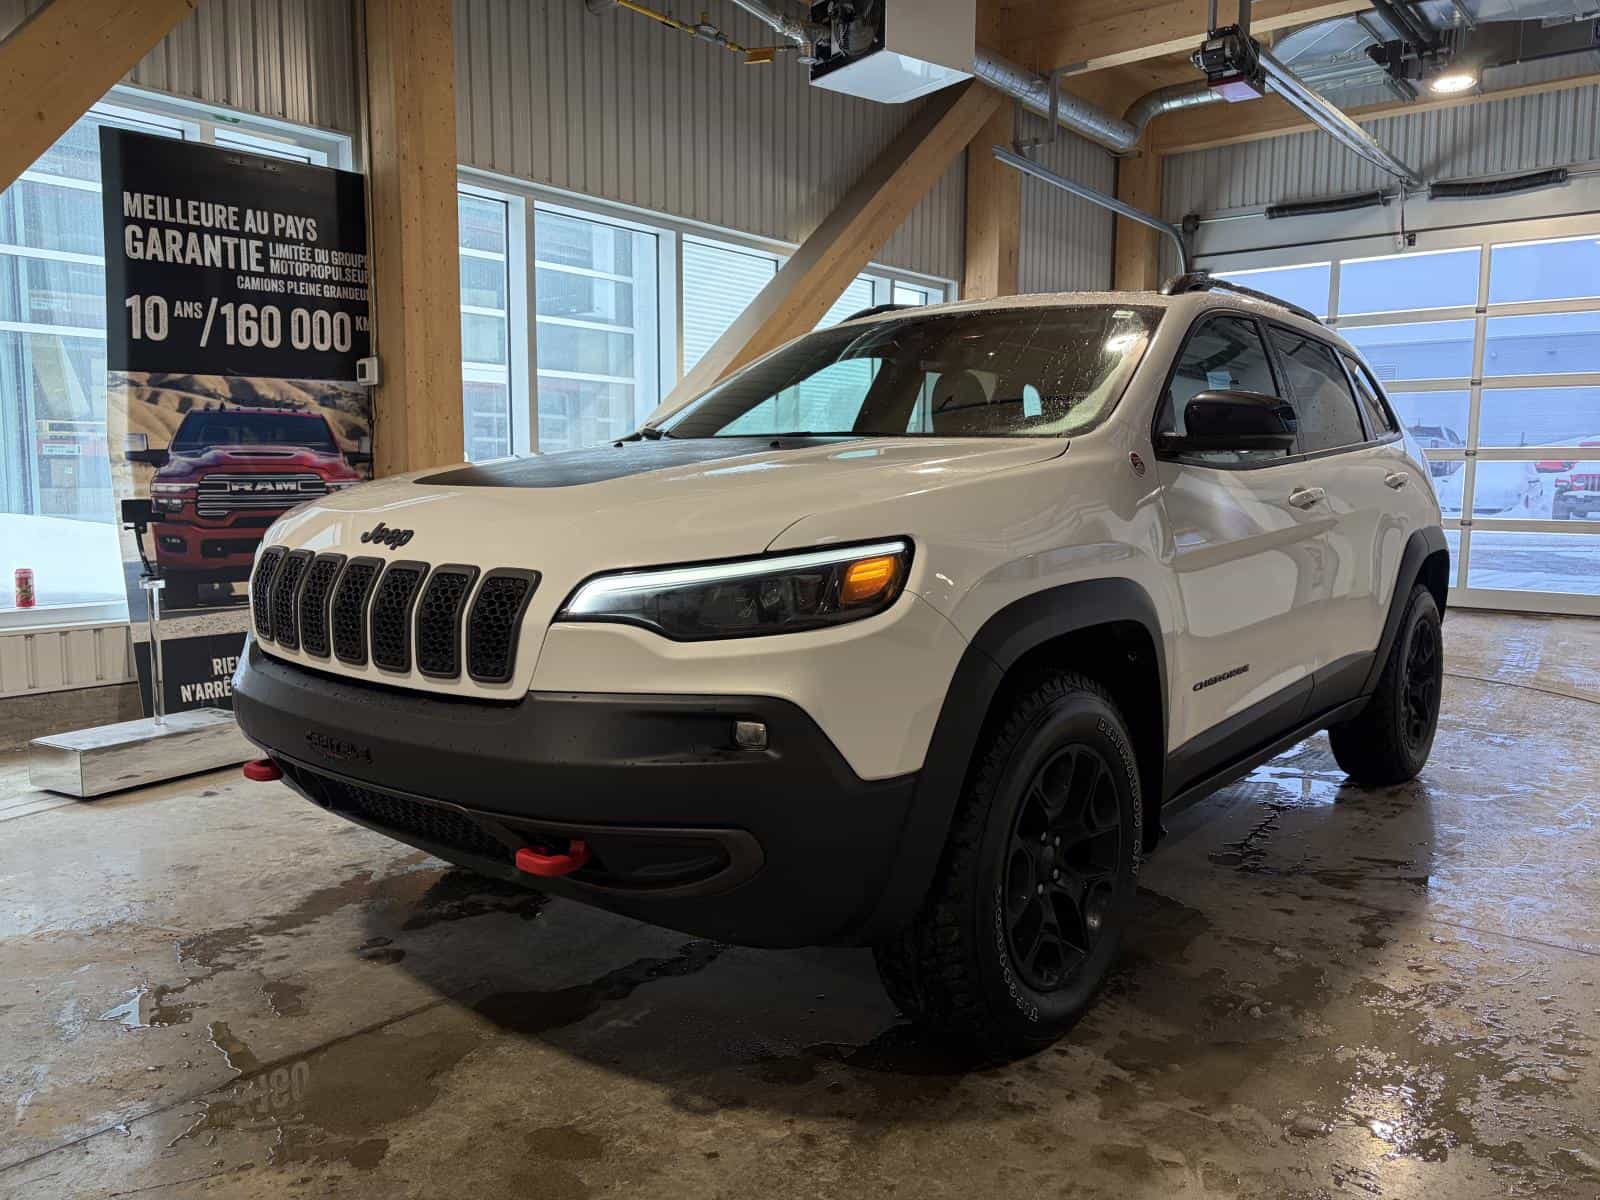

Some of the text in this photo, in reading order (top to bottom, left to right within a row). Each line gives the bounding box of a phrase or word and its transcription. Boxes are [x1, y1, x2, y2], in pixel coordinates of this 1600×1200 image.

[123, 191, 318, 242] MEILLEURE AU PAYS
[124, 224, 265, 273] GARANTIE
[268, 242, 313, 262] LIMITÉE
[314, 248, 329, 264] DU
[237, 275, 368, 301] CAMIONS PLEINE GRANDEU
[125, 294, 168, 341] 10
[174, 300, 203, 319] ANS
[290, 307, 352, 353] 000
[231, 481, 297, 491] RAM
[360, 521, 414, 551] Jeep
